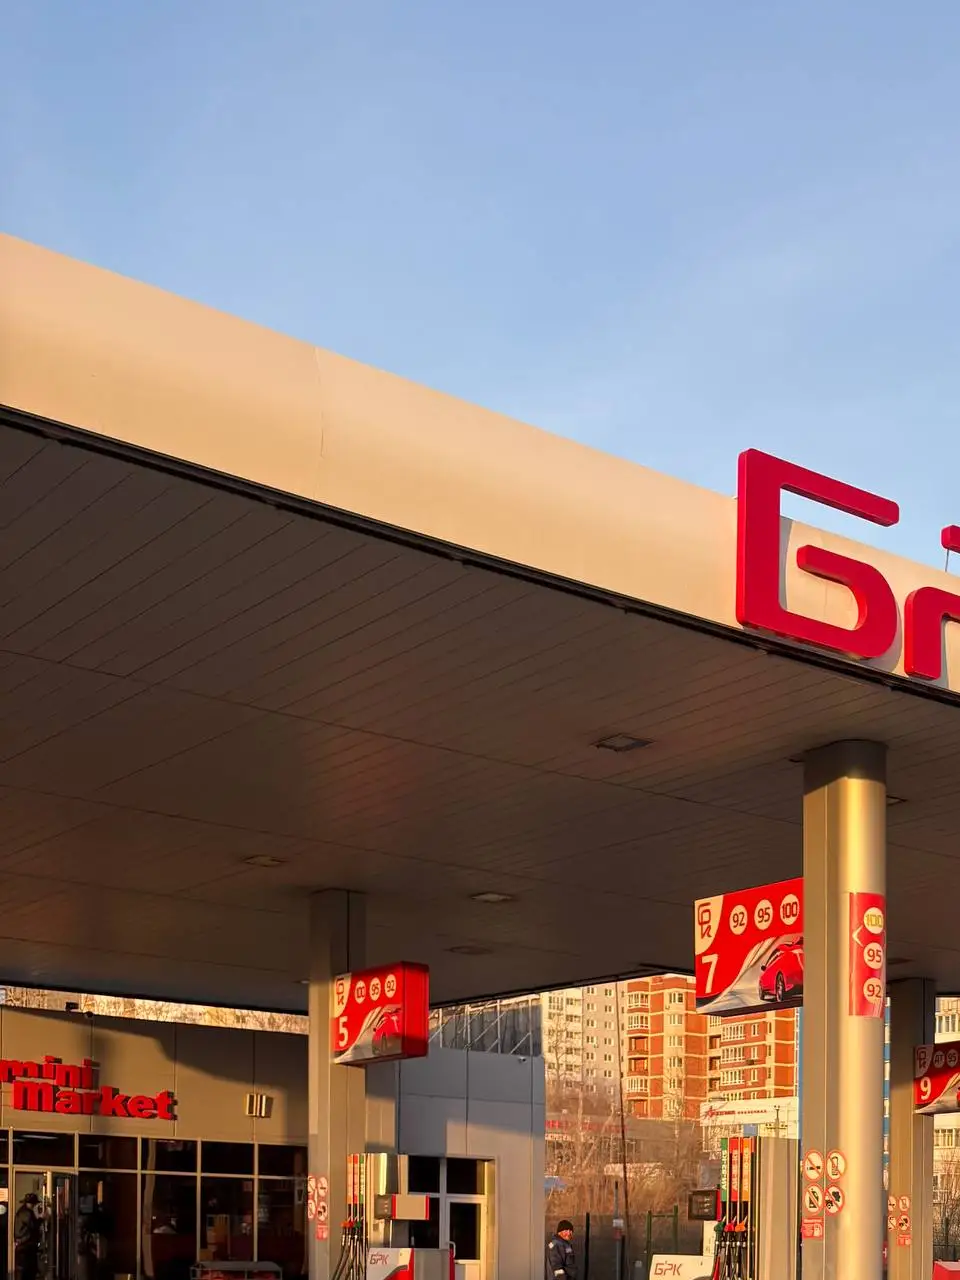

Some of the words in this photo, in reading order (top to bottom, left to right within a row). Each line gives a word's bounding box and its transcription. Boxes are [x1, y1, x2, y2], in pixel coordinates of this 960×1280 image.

[732, 912, 746, 928] 92
[757, 907, 771, 923] 95
[782, 901, 799, 920] 100
[866, 948, 882, 964] 95
[702, 954, 719, 994] 7
[371, 983, 380, 996] 95
[386, 980, 395, 993] 92
[866, 983, 882, 1000] 92
[339, 1016, 349, 1047] 5
[0, 1055, 98, 1090] mini
[920, 1077, 931, 1100] 9
